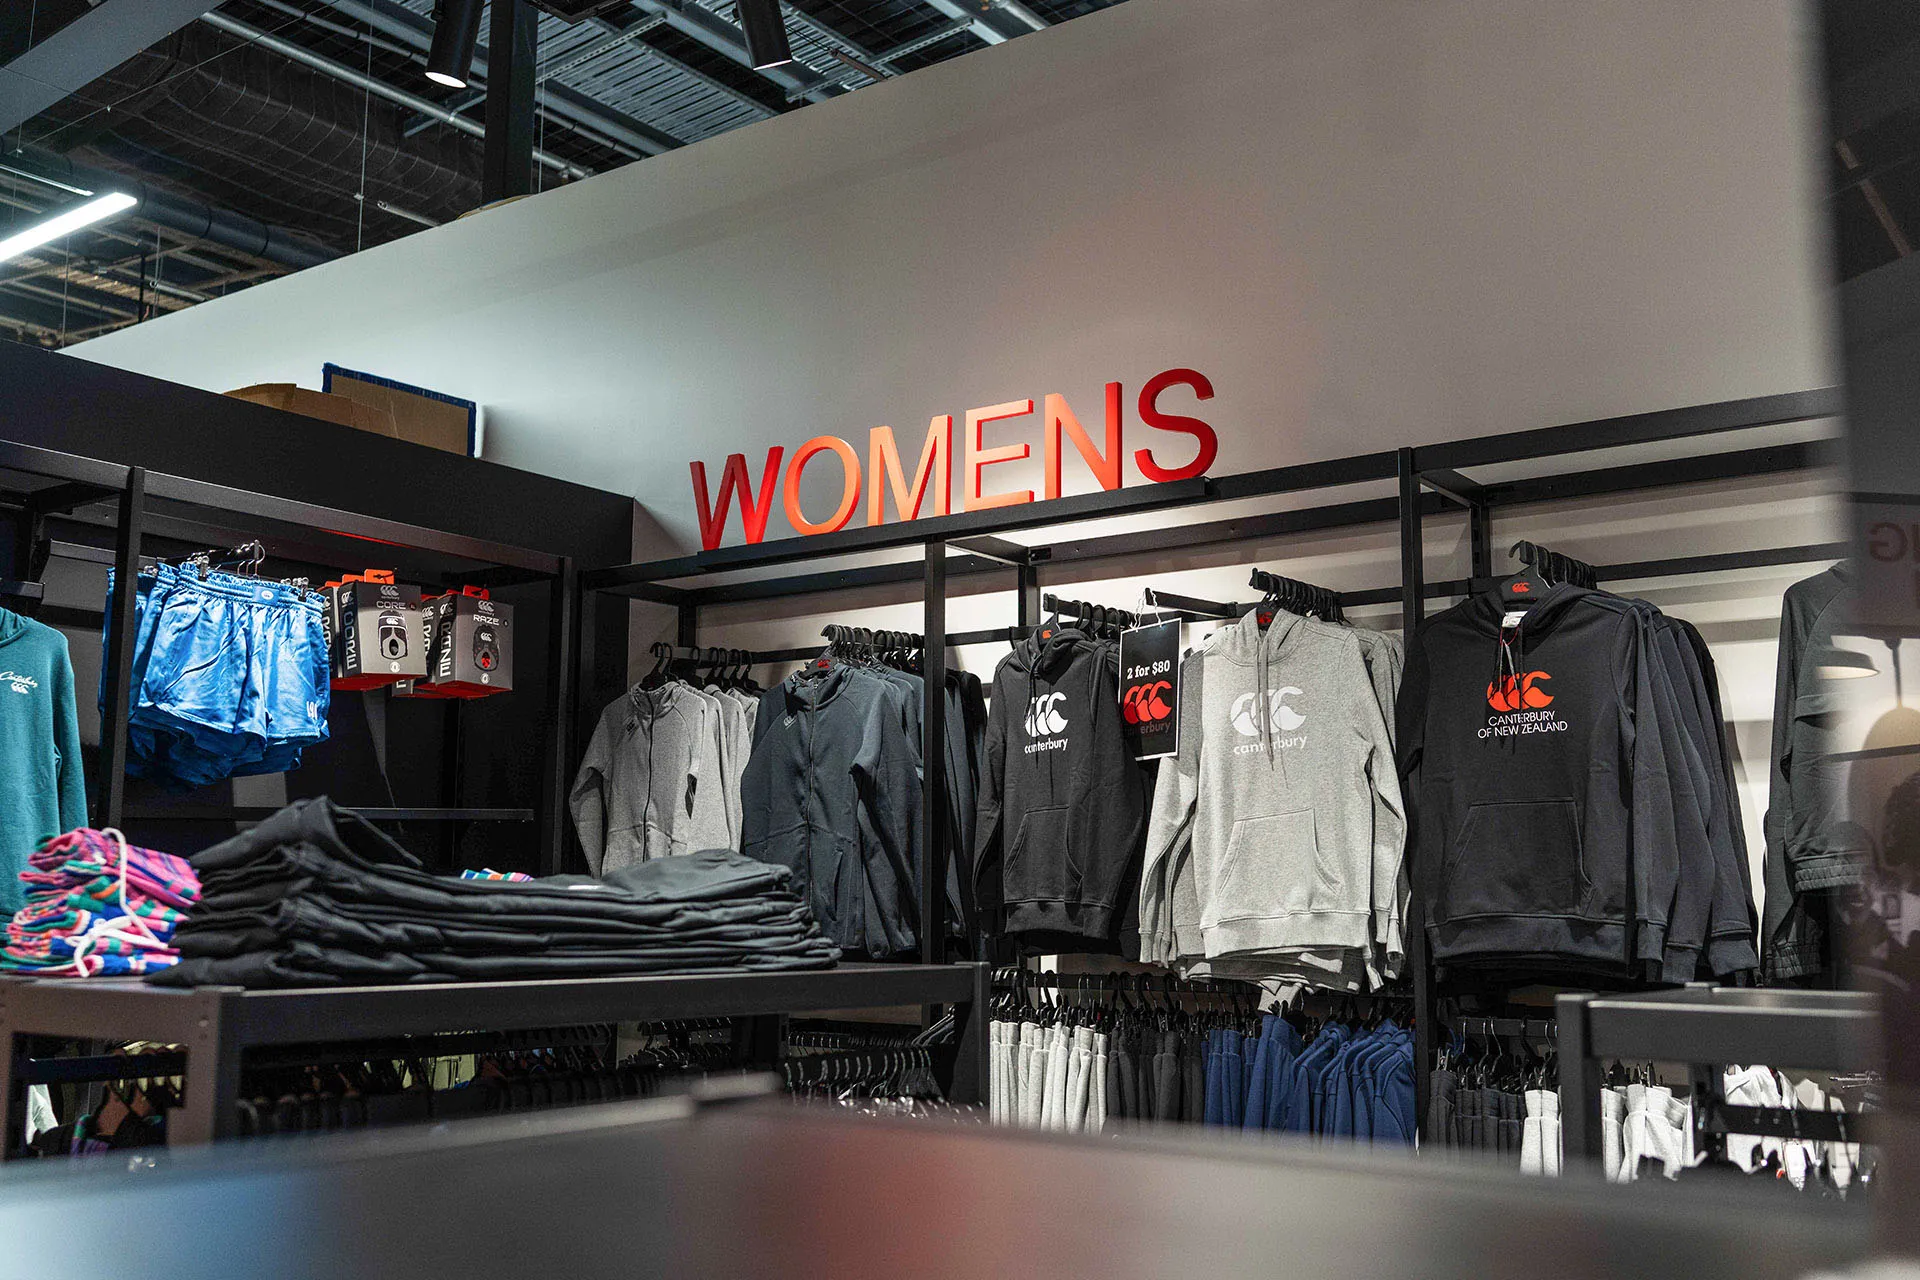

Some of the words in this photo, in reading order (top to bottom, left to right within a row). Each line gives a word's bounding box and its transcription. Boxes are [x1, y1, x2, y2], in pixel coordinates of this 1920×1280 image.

[689, 367, 1218, 551] WOMENS
[376, 600, 406, 609] CORE
[473, 614, 500, 626] RAZE
[343, 611, 357, 670] CORE
[440, 622, 452, 677] RAZE
[1127, 668, 1133, 680] 2
[1135, 664, 1150, 679] for
[1152, 660, 1171, 676] $80
[1488, 710, 1556, 727] CANTERBURY
[1477, 727, 1492, 739] OF
[1494, 724, 1520, 737] NEW
[1521, 720, 1568, 735] ZEALAND
[1233, 735, 1308, 755] cantrbury
